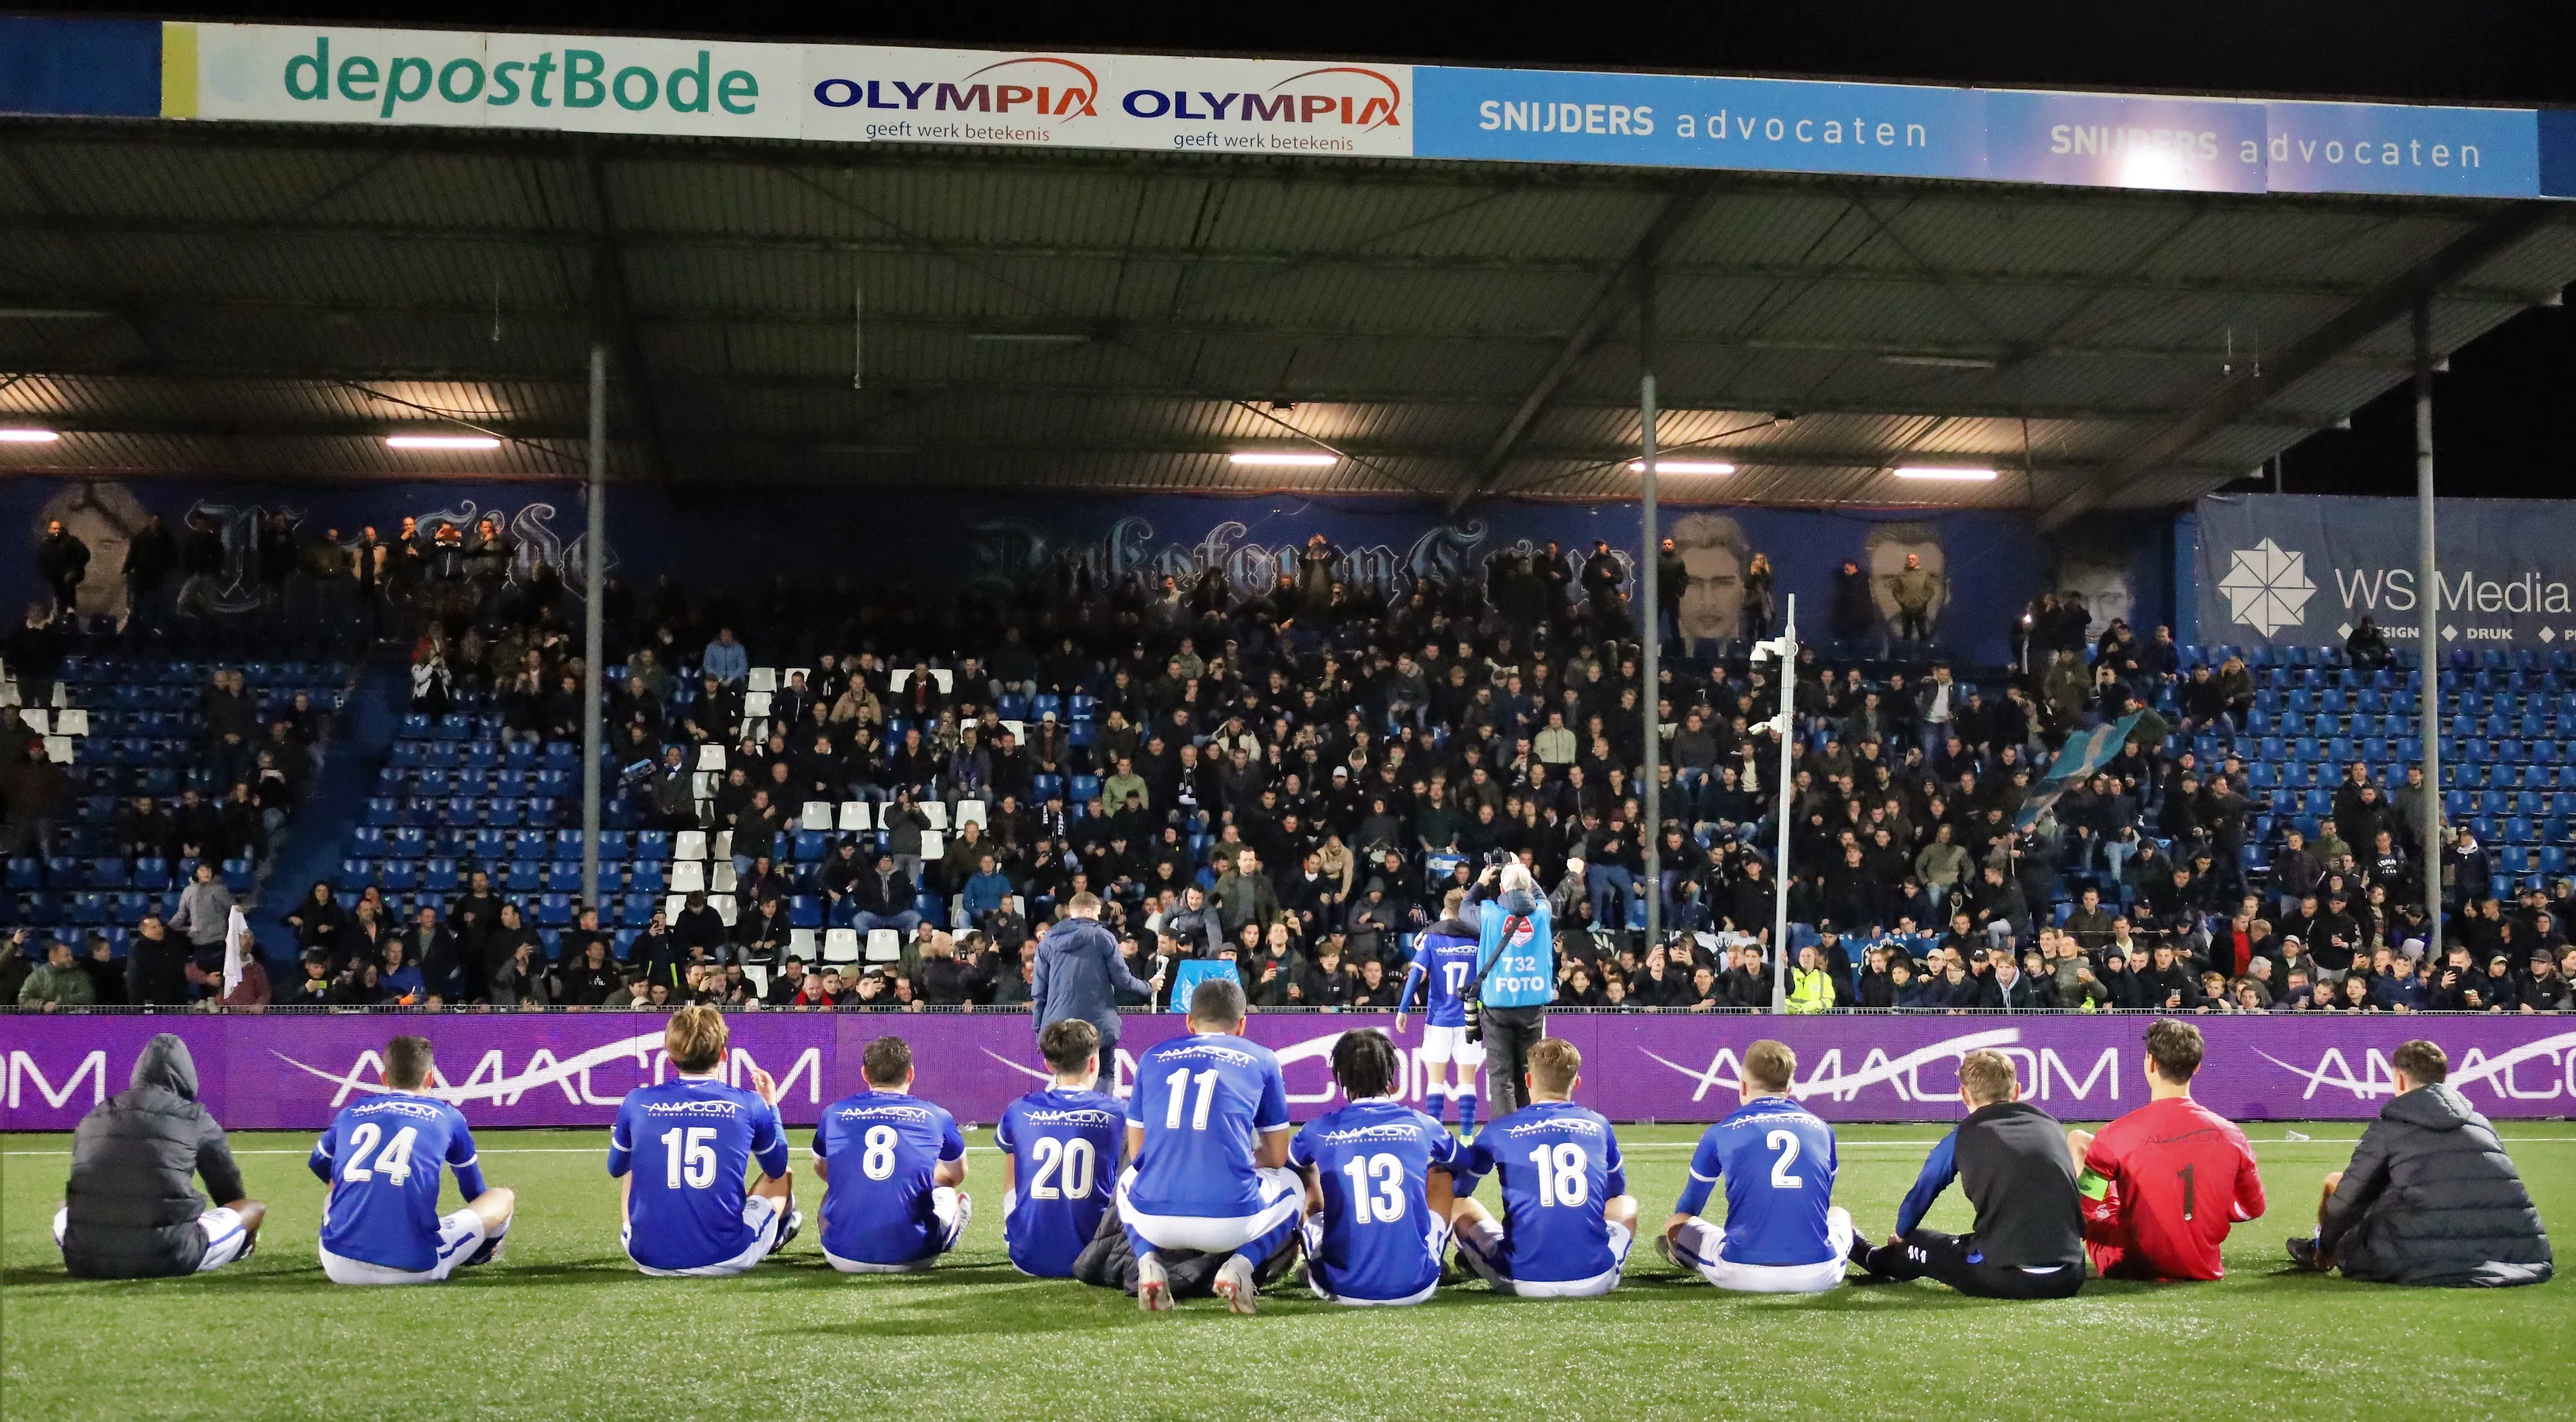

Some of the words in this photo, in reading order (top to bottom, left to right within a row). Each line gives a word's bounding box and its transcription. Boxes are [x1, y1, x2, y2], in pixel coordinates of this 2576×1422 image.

[284, 36, 759, 117] depostBode
[814, 76, 1098, 119] OLYMPIA
[1122, 87, 1401, 127] OLYMPIA
[1479, 101, 1654, 135] SNIJDERS
[1677, 109, 1925, 147] advocaten
[866, 122, 912, 142] geeft
[917, 122, 959, 139] werk
[965, 123, 1050, 142] betekenis
[1174, 131, 1220, 150] geeft
[1224, 132, 1266, 149] werk
[1270, 133, 1354, 152] betekenis
[2051, 124, 2218, 161] SNIJDERS
[2241, 132, 2479, 168] advocaten
[2334, 568, 2416, 611] WS
[2434, 571, 2571, 613] Media
[2376, 626, 2419, 638] SIGN
[2467, 628, 2513, 639] DRUK
[1443, 961, 1469, 995] 17
[1495, 976, 1545, 992] FOTO
[1502, 956, 1536, 972] 732
[1156, 1046, 1252, 1064] AMACOM
[0, 1048, 107, 1109] M
[1166, 1068, 1218, 1130] 11
[353, 1101, 440, 1118] AMACOM
[645, 1100, 739, 1114] AMACOM
[839, 1107, 928, 1119] AMACOM
[1027, 1109, 1111, 1124] AMACOM
[1507, 1118, 1600, 1134] AMACOM
[343, 1122, 418, 1187] 24
[863, 1125, 898, 1181] 8
[1322, 1124, 1419, 1142] AMACOM
[661, 1127, 717, 1189] 15
[1030, 1136, 1095, 1200] 20
[1529, 1142, 1588, 1207] 18
[1766, 1130, 1802, 1188] 2
[1344, 1152, 1405, 1224] 13
[2177, 1163, 2194, 1221] 1
